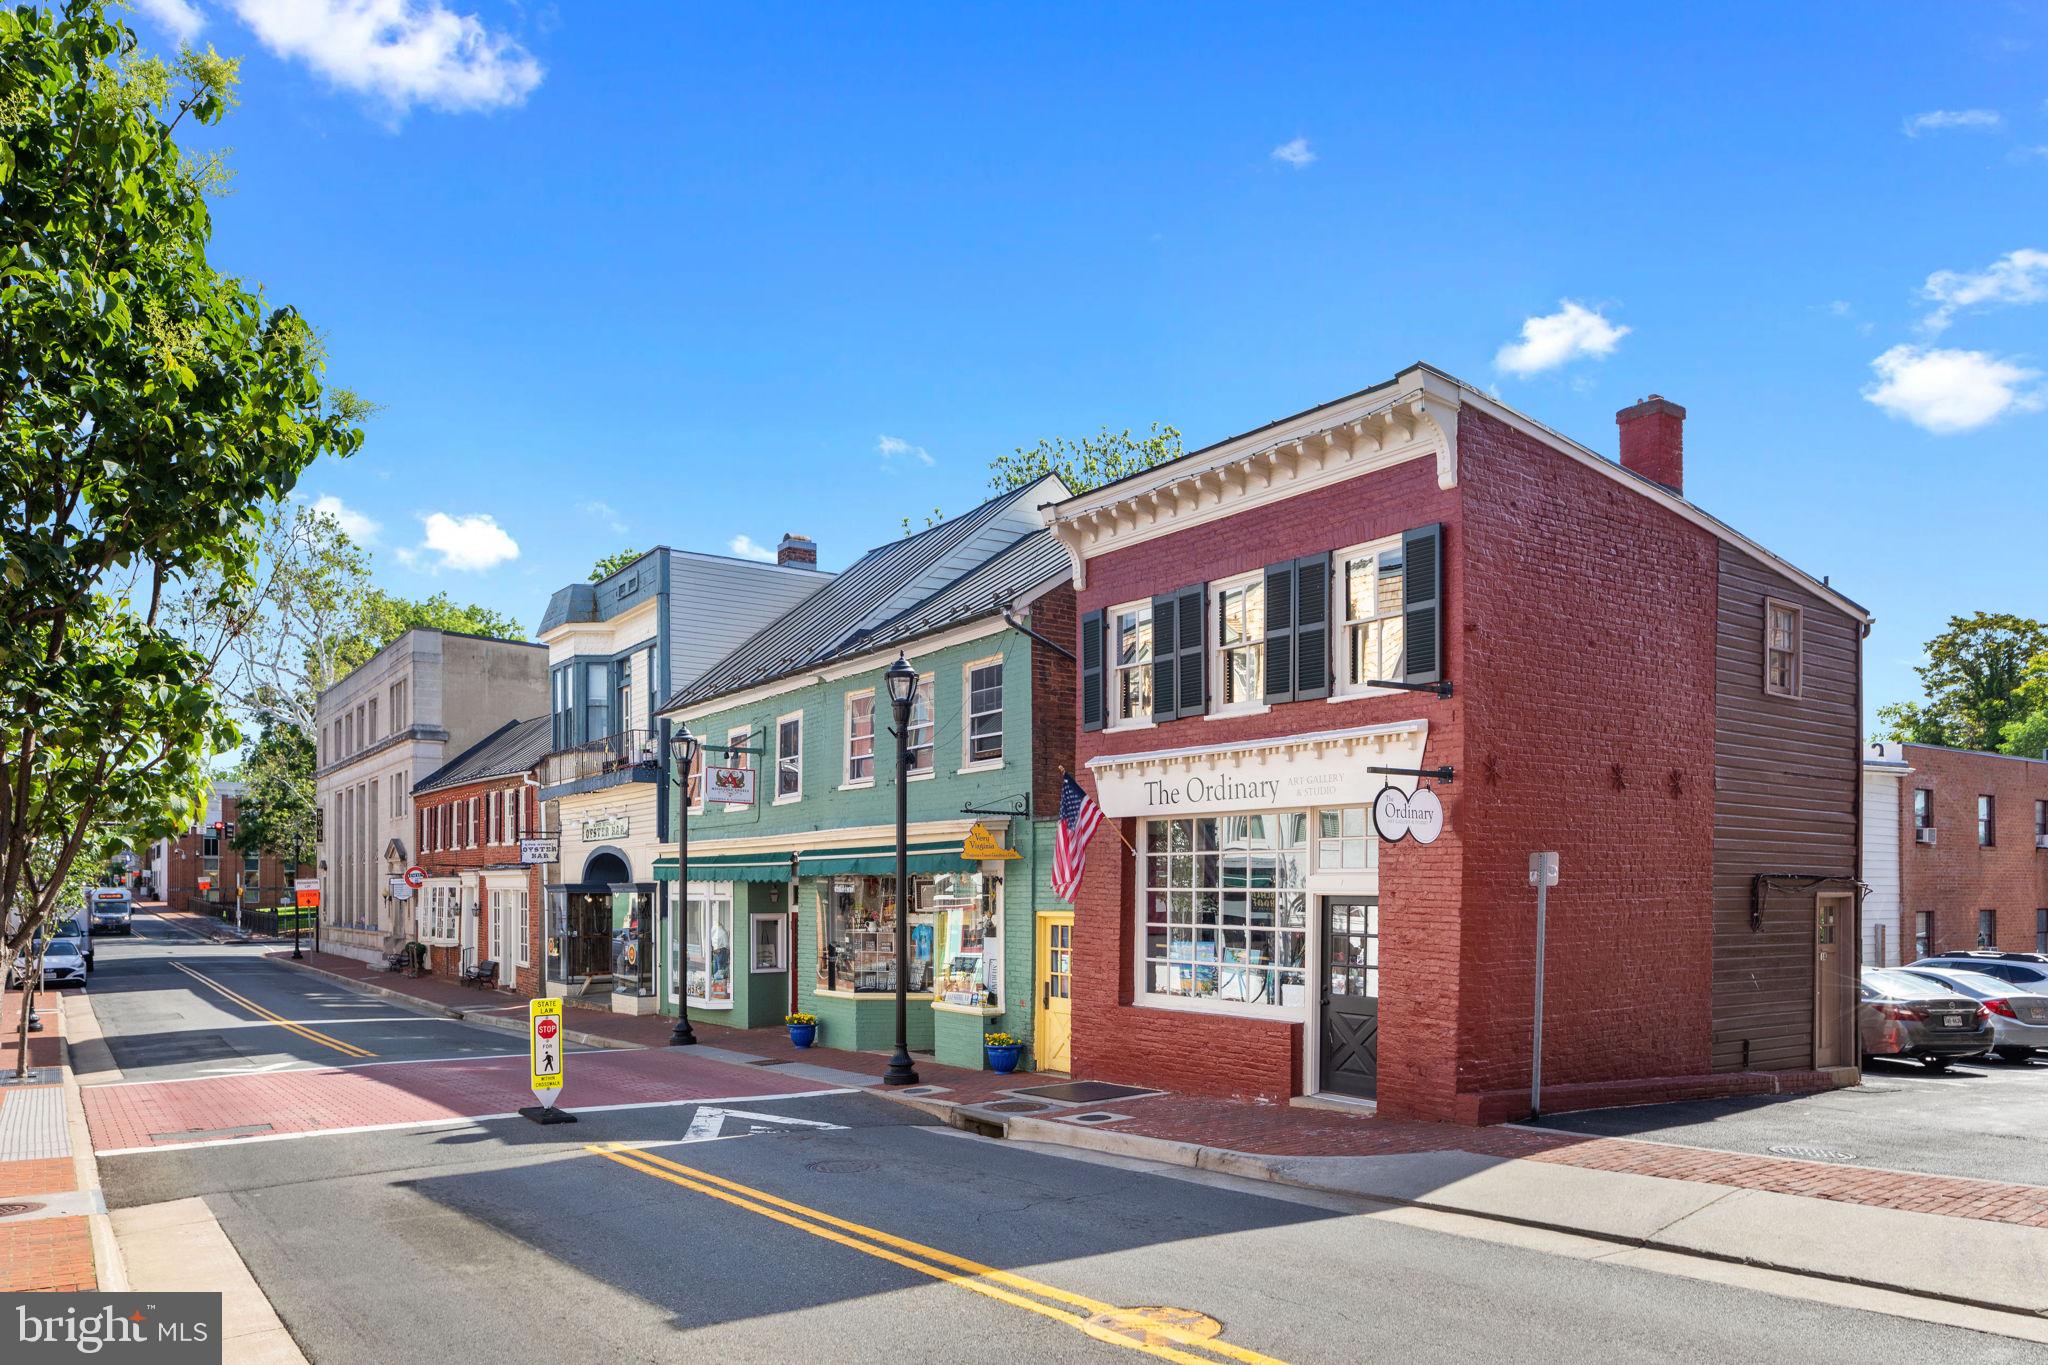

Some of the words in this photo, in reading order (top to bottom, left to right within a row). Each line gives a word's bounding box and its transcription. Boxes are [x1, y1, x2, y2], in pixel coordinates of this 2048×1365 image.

[1288, 776, 1304, 786] ART
[1306, 773, 1345, 785] GALLERY
[1144, 780, 1180, 806] The
[1186, 773, 1280, 804] Ordinary
[1305, 786, 1337, 797] STUDIO
[1385, 803, 1434, 823] Ordinary
[537, 1000, 556, 1008] STATE
[538, 1026, 556, 1034] STOP
